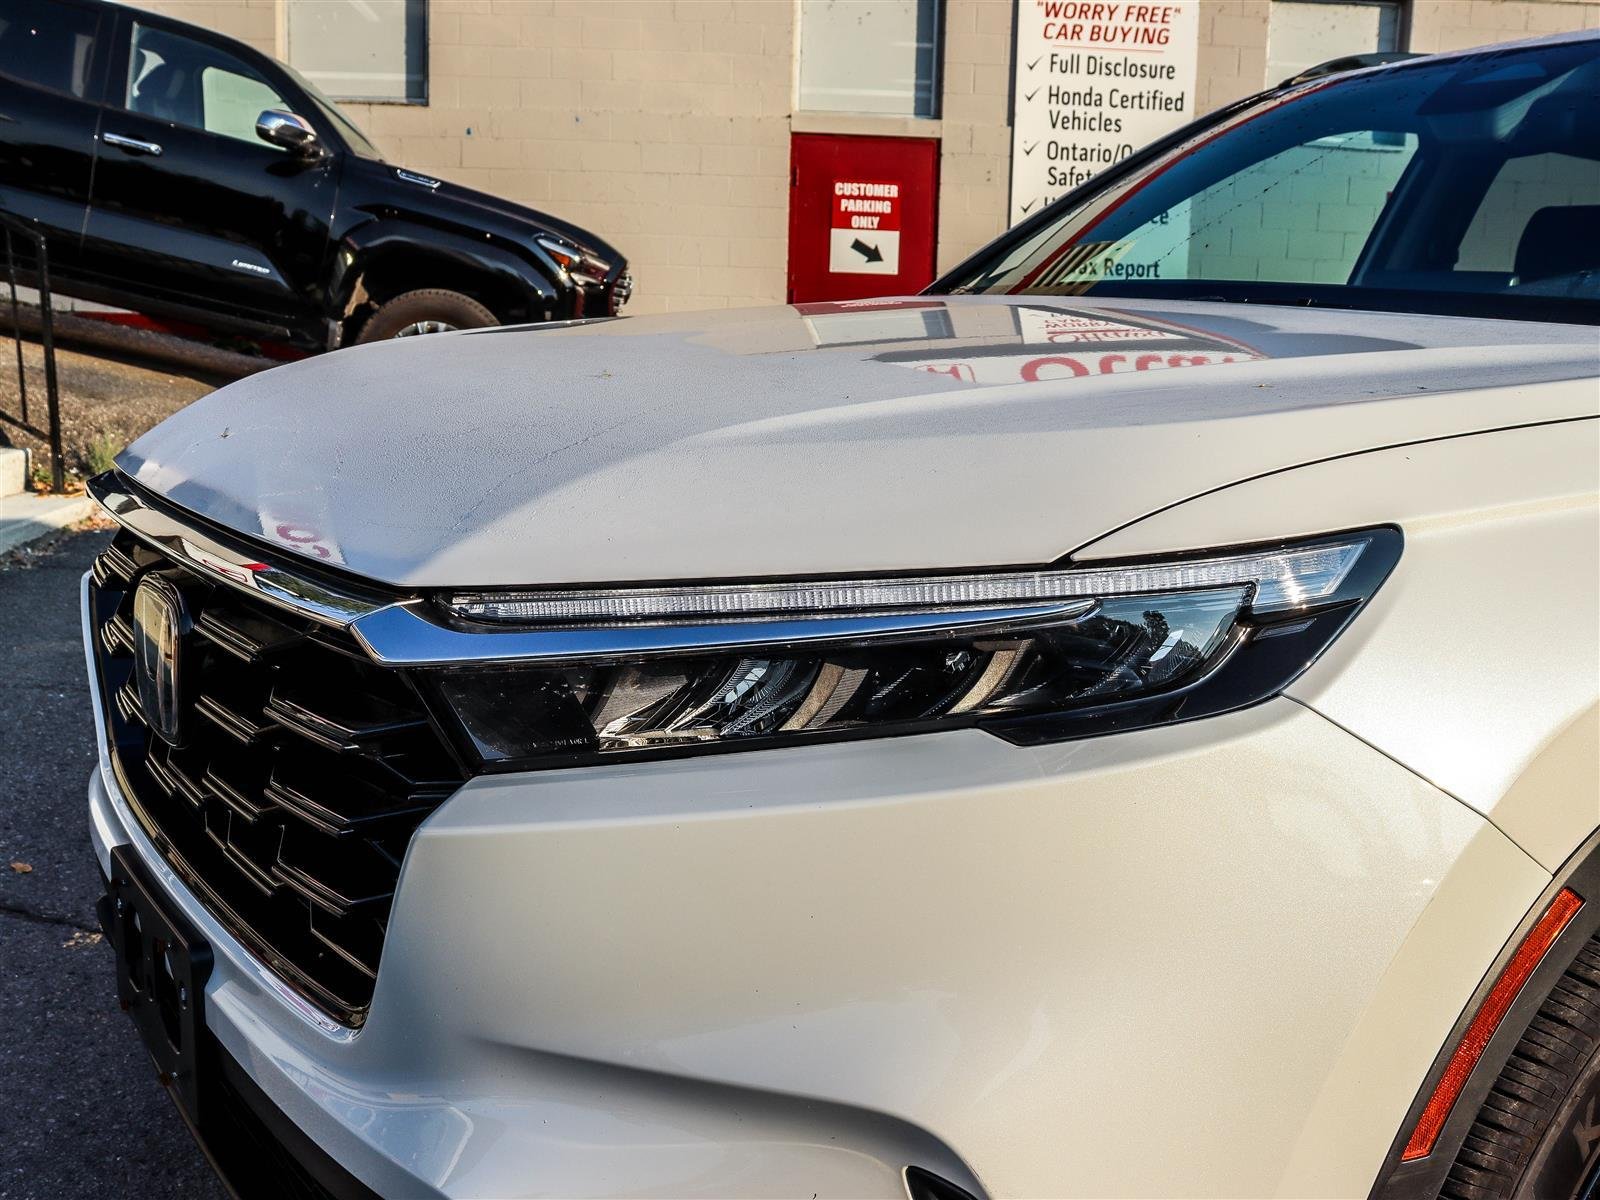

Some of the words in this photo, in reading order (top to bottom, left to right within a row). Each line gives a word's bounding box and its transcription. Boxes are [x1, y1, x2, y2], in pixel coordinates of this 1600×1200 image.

[1043, 22, 1083, 41] CAR
[1090, 25, 1170, 45] BUYING
[1050, 54, 1080, 74] Full
[1087, 56, 1175, 79] Disclosure
[1049, 85, 1103, 106] Honda
[1109, 89, 1184, 111] Certified
[1049, 110, 1122, 132] Vehicles
[1047, 166, 1096, 187] Safet
[834, 182, 898, 198] CUSTOMER
[840, 199, 892, 214] PARKING
[851, 215, 880, 229] ONLY
[1104, 258, 1160, 280] Report
